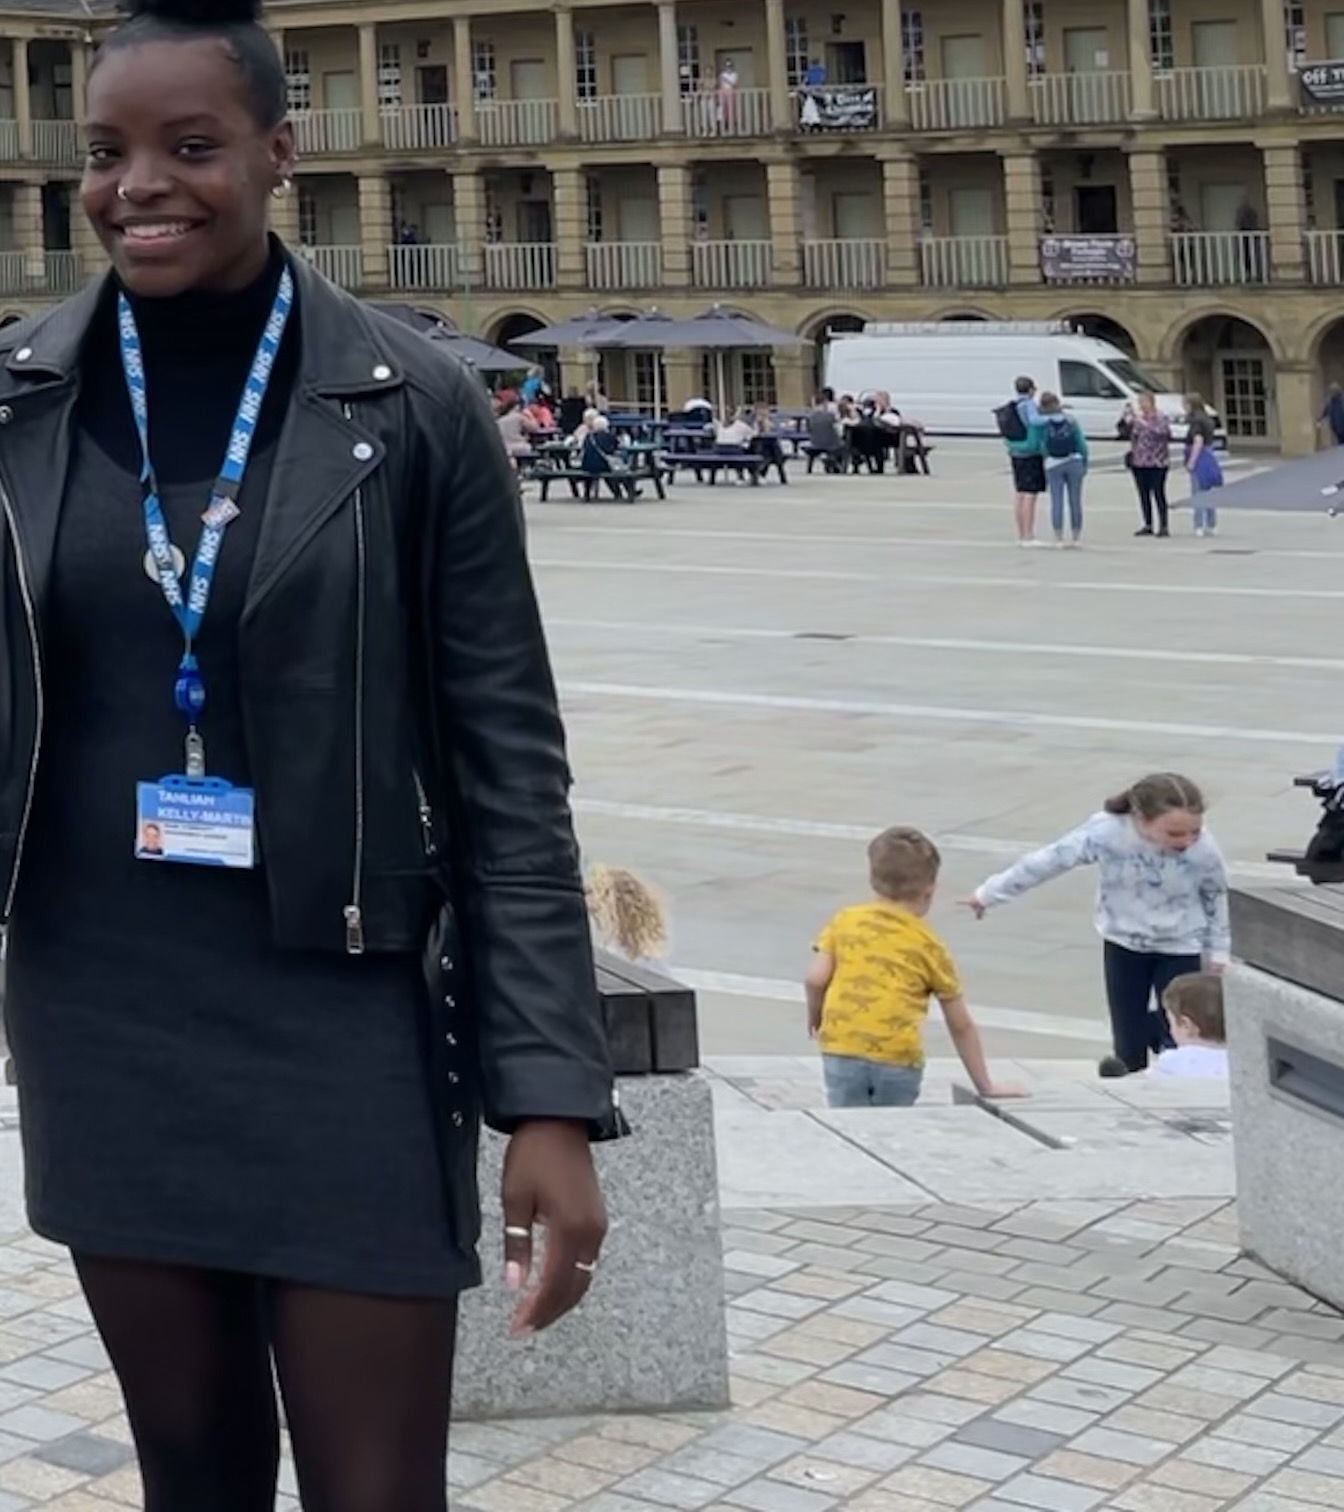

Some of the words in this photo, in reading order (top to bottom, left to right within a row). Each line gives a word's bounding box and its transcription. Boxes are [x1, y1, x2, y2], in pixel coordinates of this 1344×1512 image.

[251, 348, 274, 383] NHS
[238, 389, 261, 424] NHS
[226, 429, 250, 464] NHS
[196, 528, 220, 566] NHS
[159, 569, 182, 606] NHS
[189, 576, 209, 614] NHS
